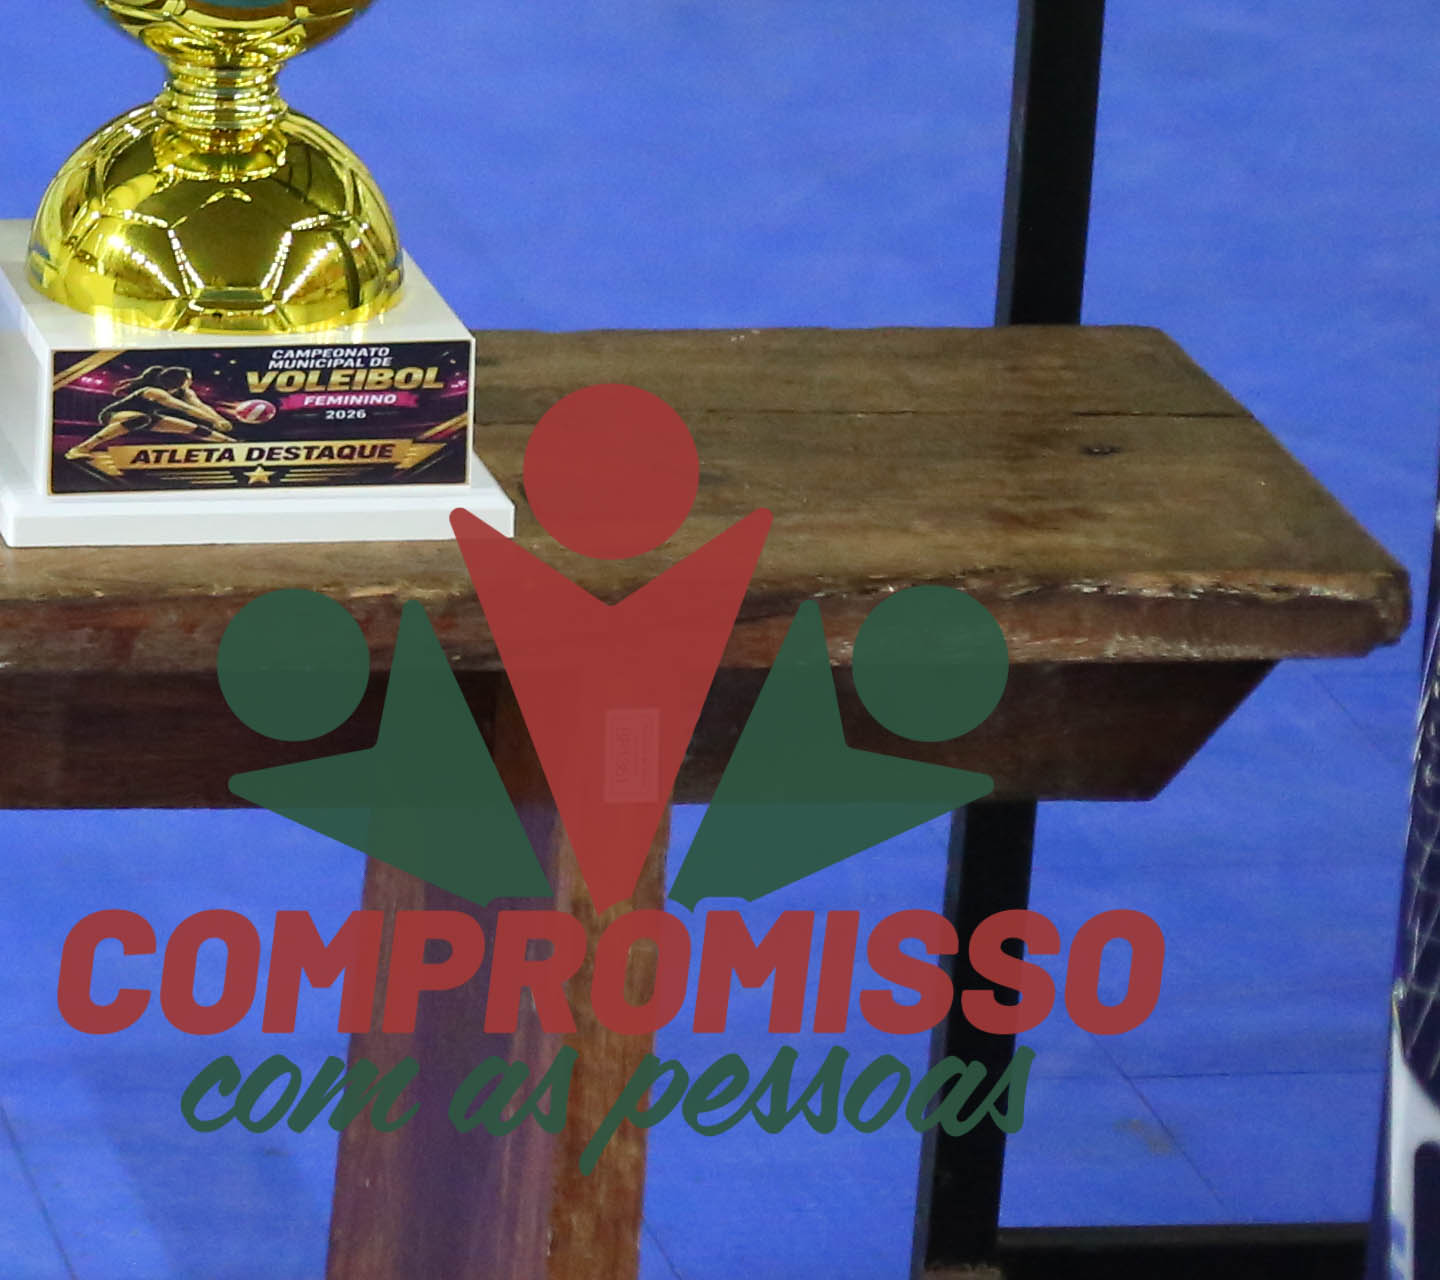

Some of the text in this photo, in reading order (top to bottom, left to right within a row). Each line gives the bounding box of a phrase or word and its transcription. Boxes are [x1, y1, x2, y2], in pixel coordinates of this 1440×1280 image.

[272, 347, 390, 360] CAMPEONATO
[269, 356, 391, 370] MUNICIPAL DE
[247, 366, 444, 394] VOLEIBOL
[303, 394, 397, 406] FEMININO
[325, 409, 366, 421] 2026
[131, 443, 395, 465] ATLETA DESTAQUE
